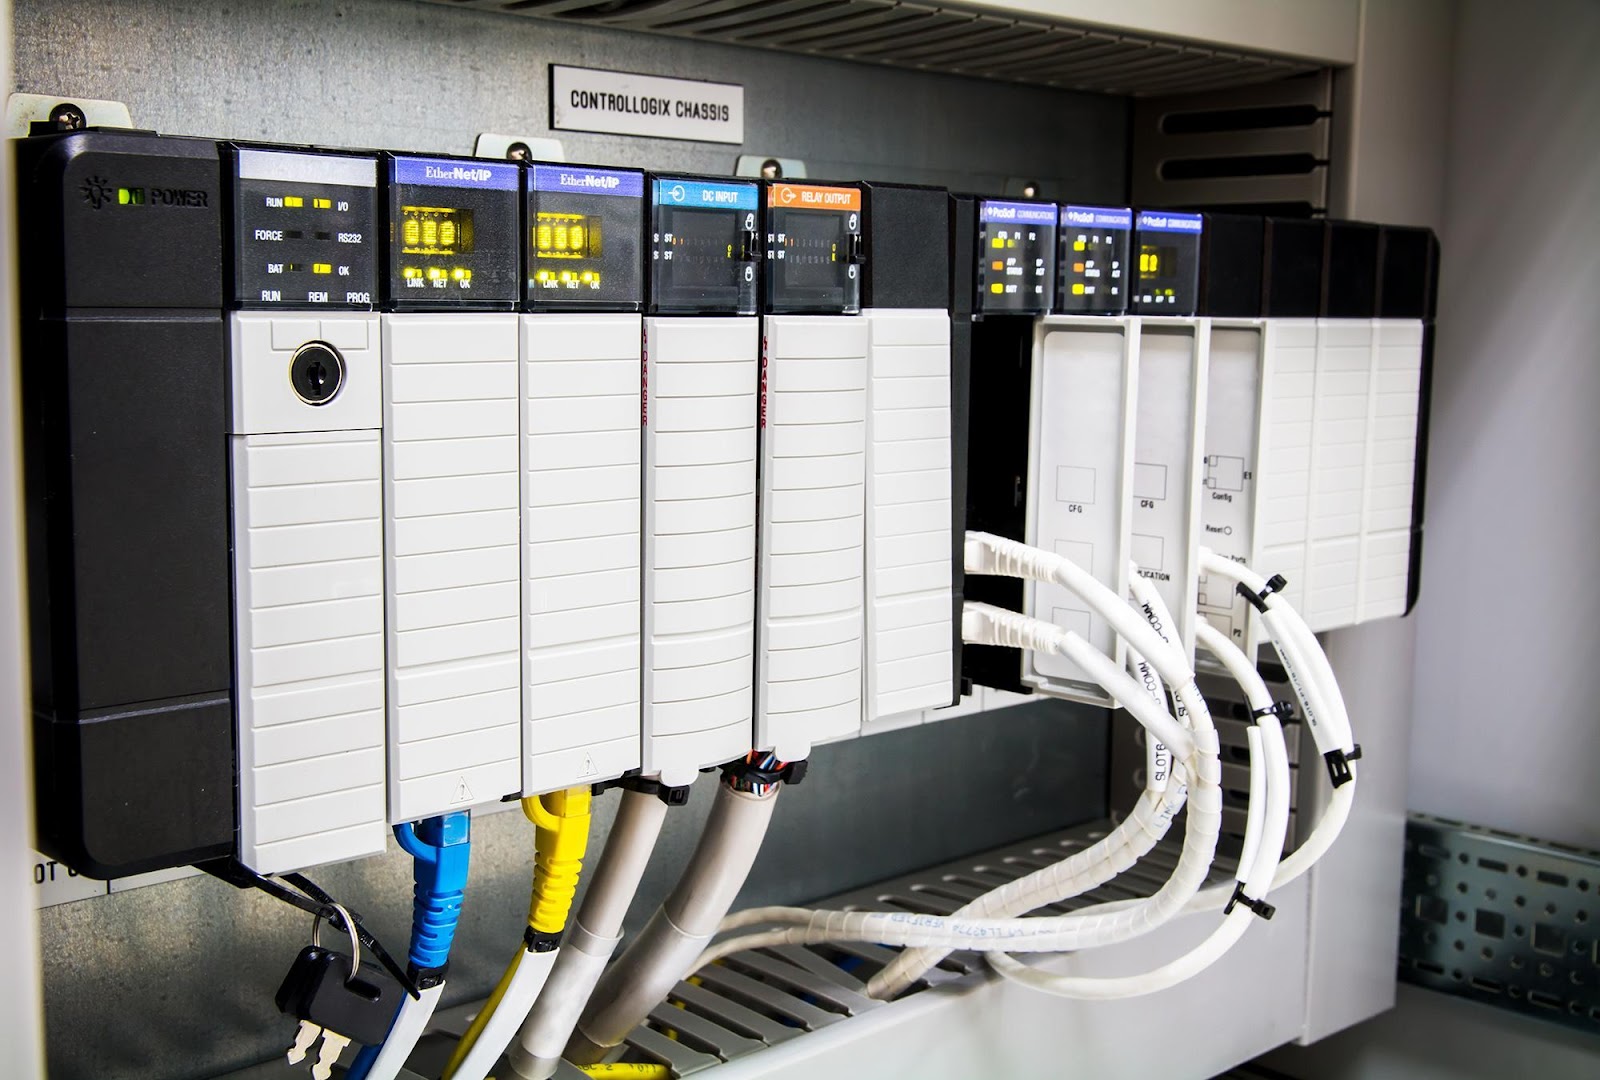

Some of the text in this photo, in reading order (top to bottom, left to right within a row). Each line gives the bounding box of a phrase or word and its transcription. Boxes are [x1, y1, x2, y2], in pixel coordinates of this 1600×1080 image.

[571, 90, 729, 122] CONTROLLOGIX CHASSIS
[425, 165, 492, 182] EtherNet/IP
[559, 173, 620, 189] EtherNet/IP
[151, 188, 208, 208] POWER
[702, 189, 738, 203] DC INPUT
[801, 187, 851, 204] RELAY OUTPUT
[266, 197, 283, 208] RUN
[338, 201, 349, 212] I/O
[255, 230, 284, 241] FORCE
[338, 233, 362, 244] RS232
[268, 264, 284, 274] BAT
[338, 266, 350, 276] OK
[406, 278, 471, 289] LINK NET OK
[542, 280, 600, 290] LINK NET OK
[261, 290, 370, 304] RUN REM PROG
[760, 356, 768, 430] DANGER
[1068, 504, 1082, 514] CFG
[1140, 500, 1154, 509] CFG
[1136, 569, 1170, 582] LICATION
